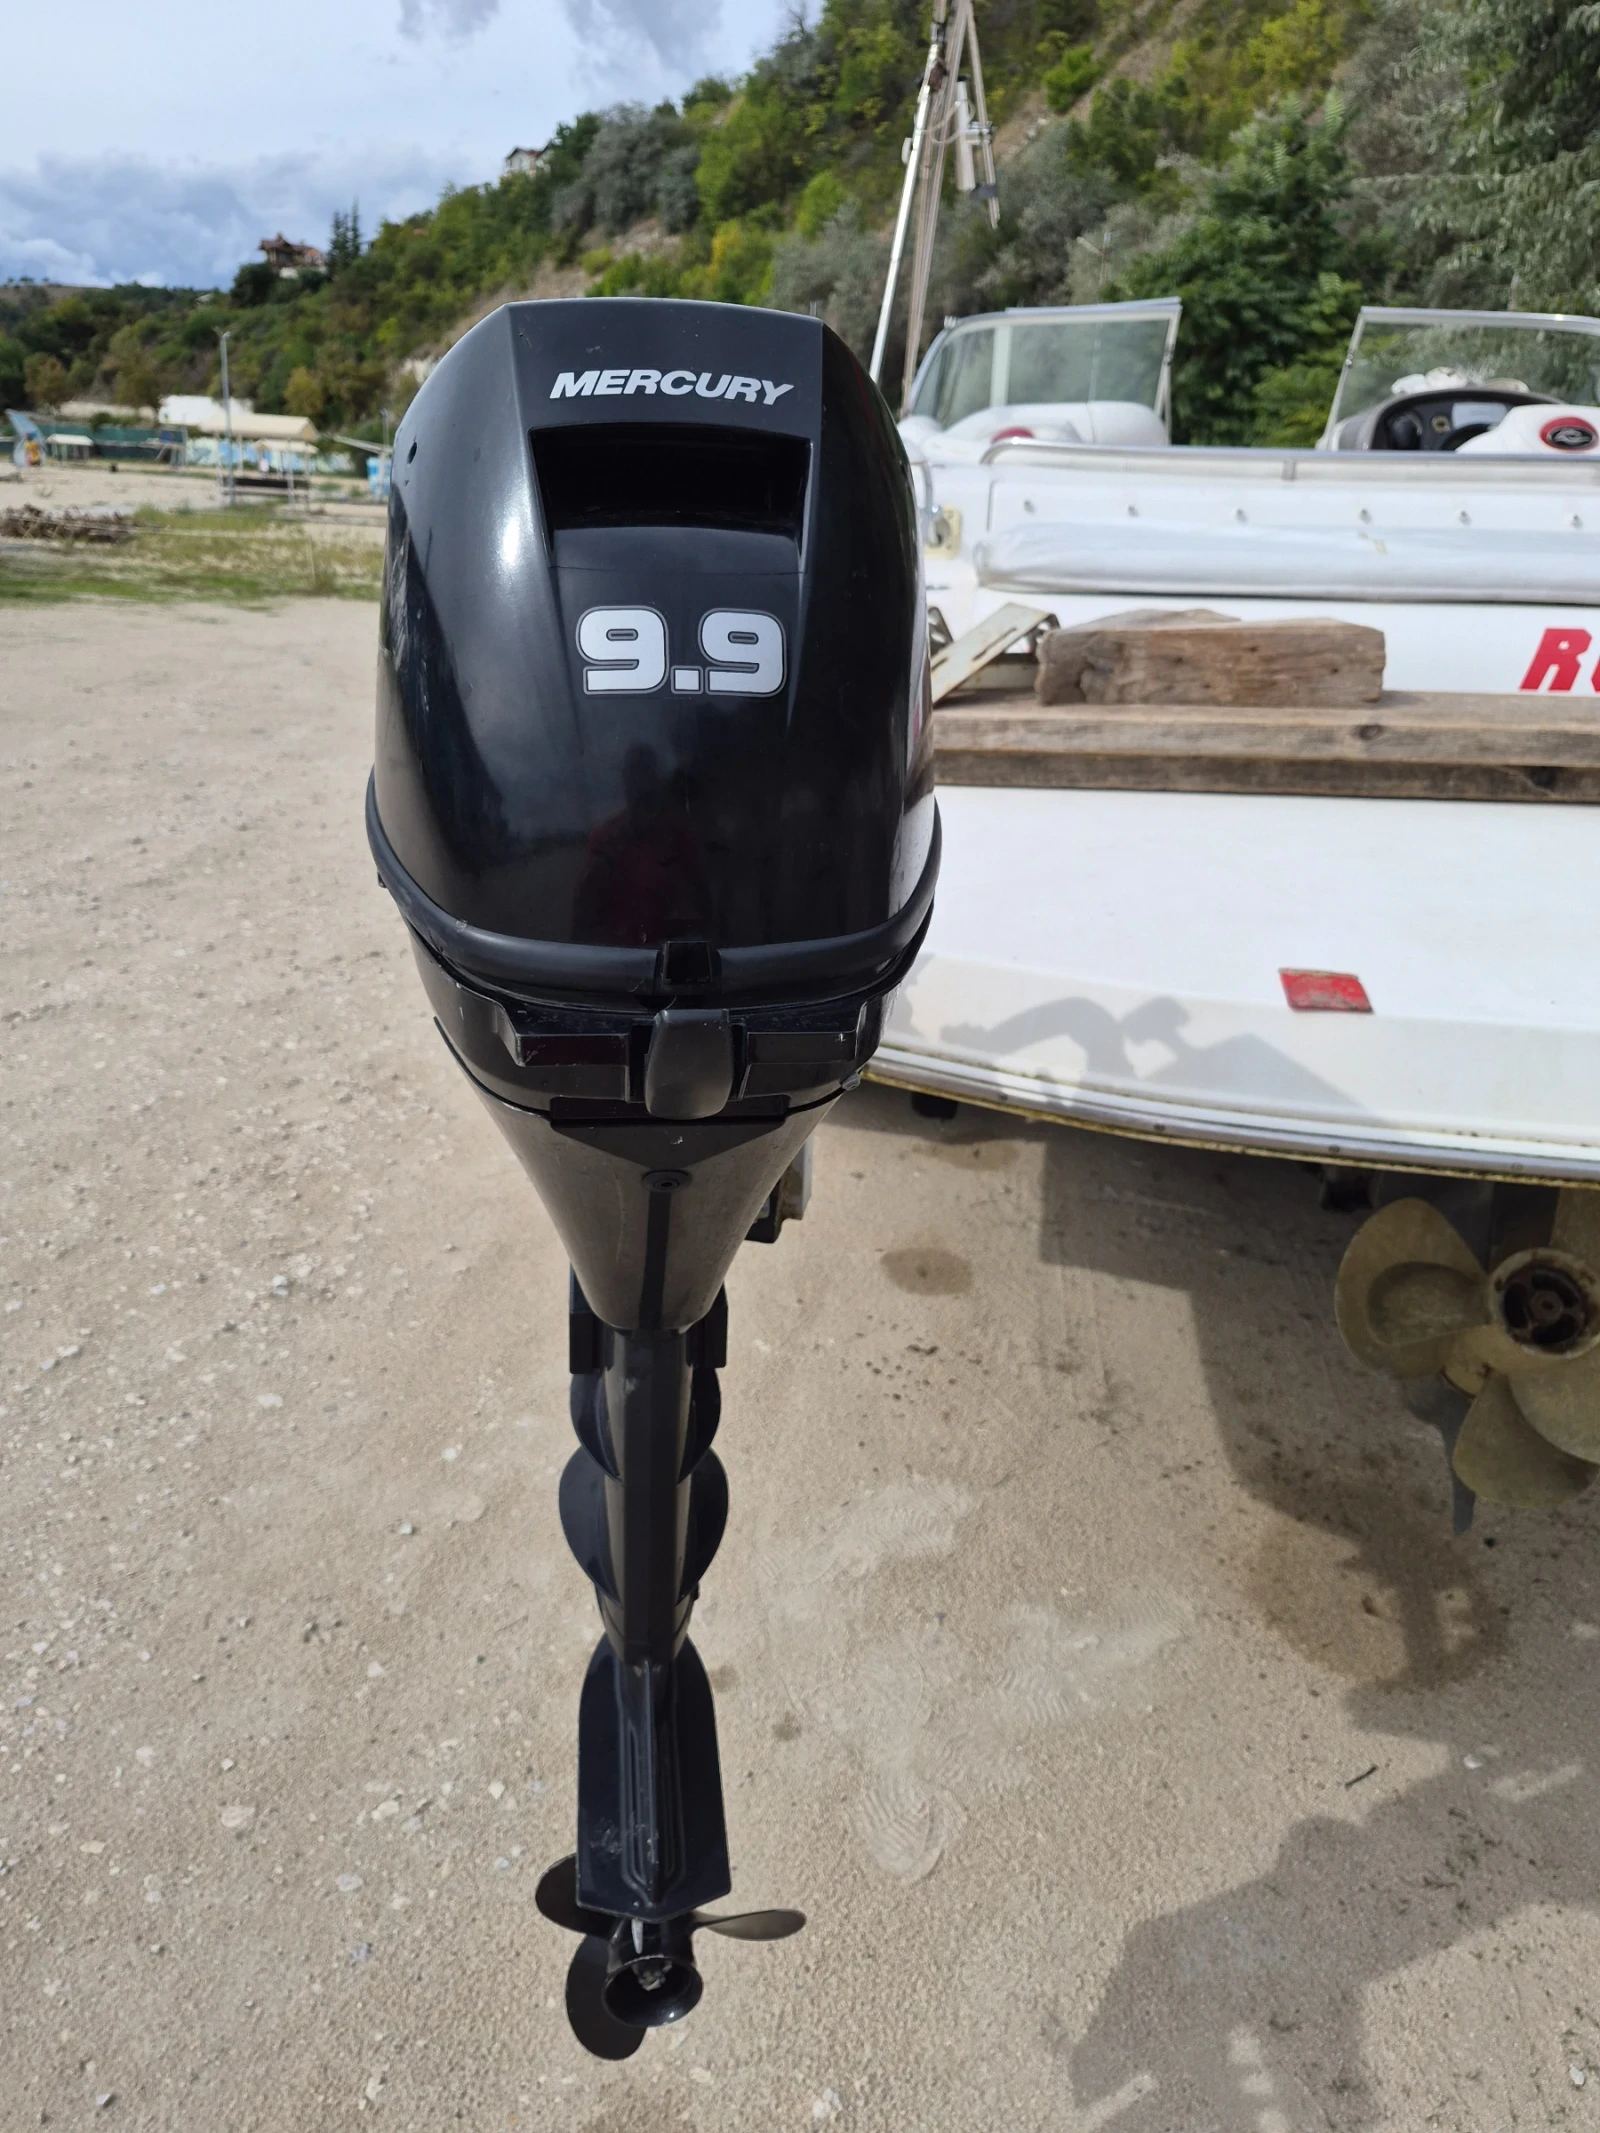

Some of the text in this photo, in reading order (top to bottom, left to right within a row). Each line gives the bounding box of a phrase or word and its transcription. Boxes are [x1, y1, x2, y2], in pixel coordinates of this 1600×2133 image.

[550, 369, 794, 405] MERCURY
[577, 606, 786, 696] 9.9
[1519, 627, 1600, 692] R
